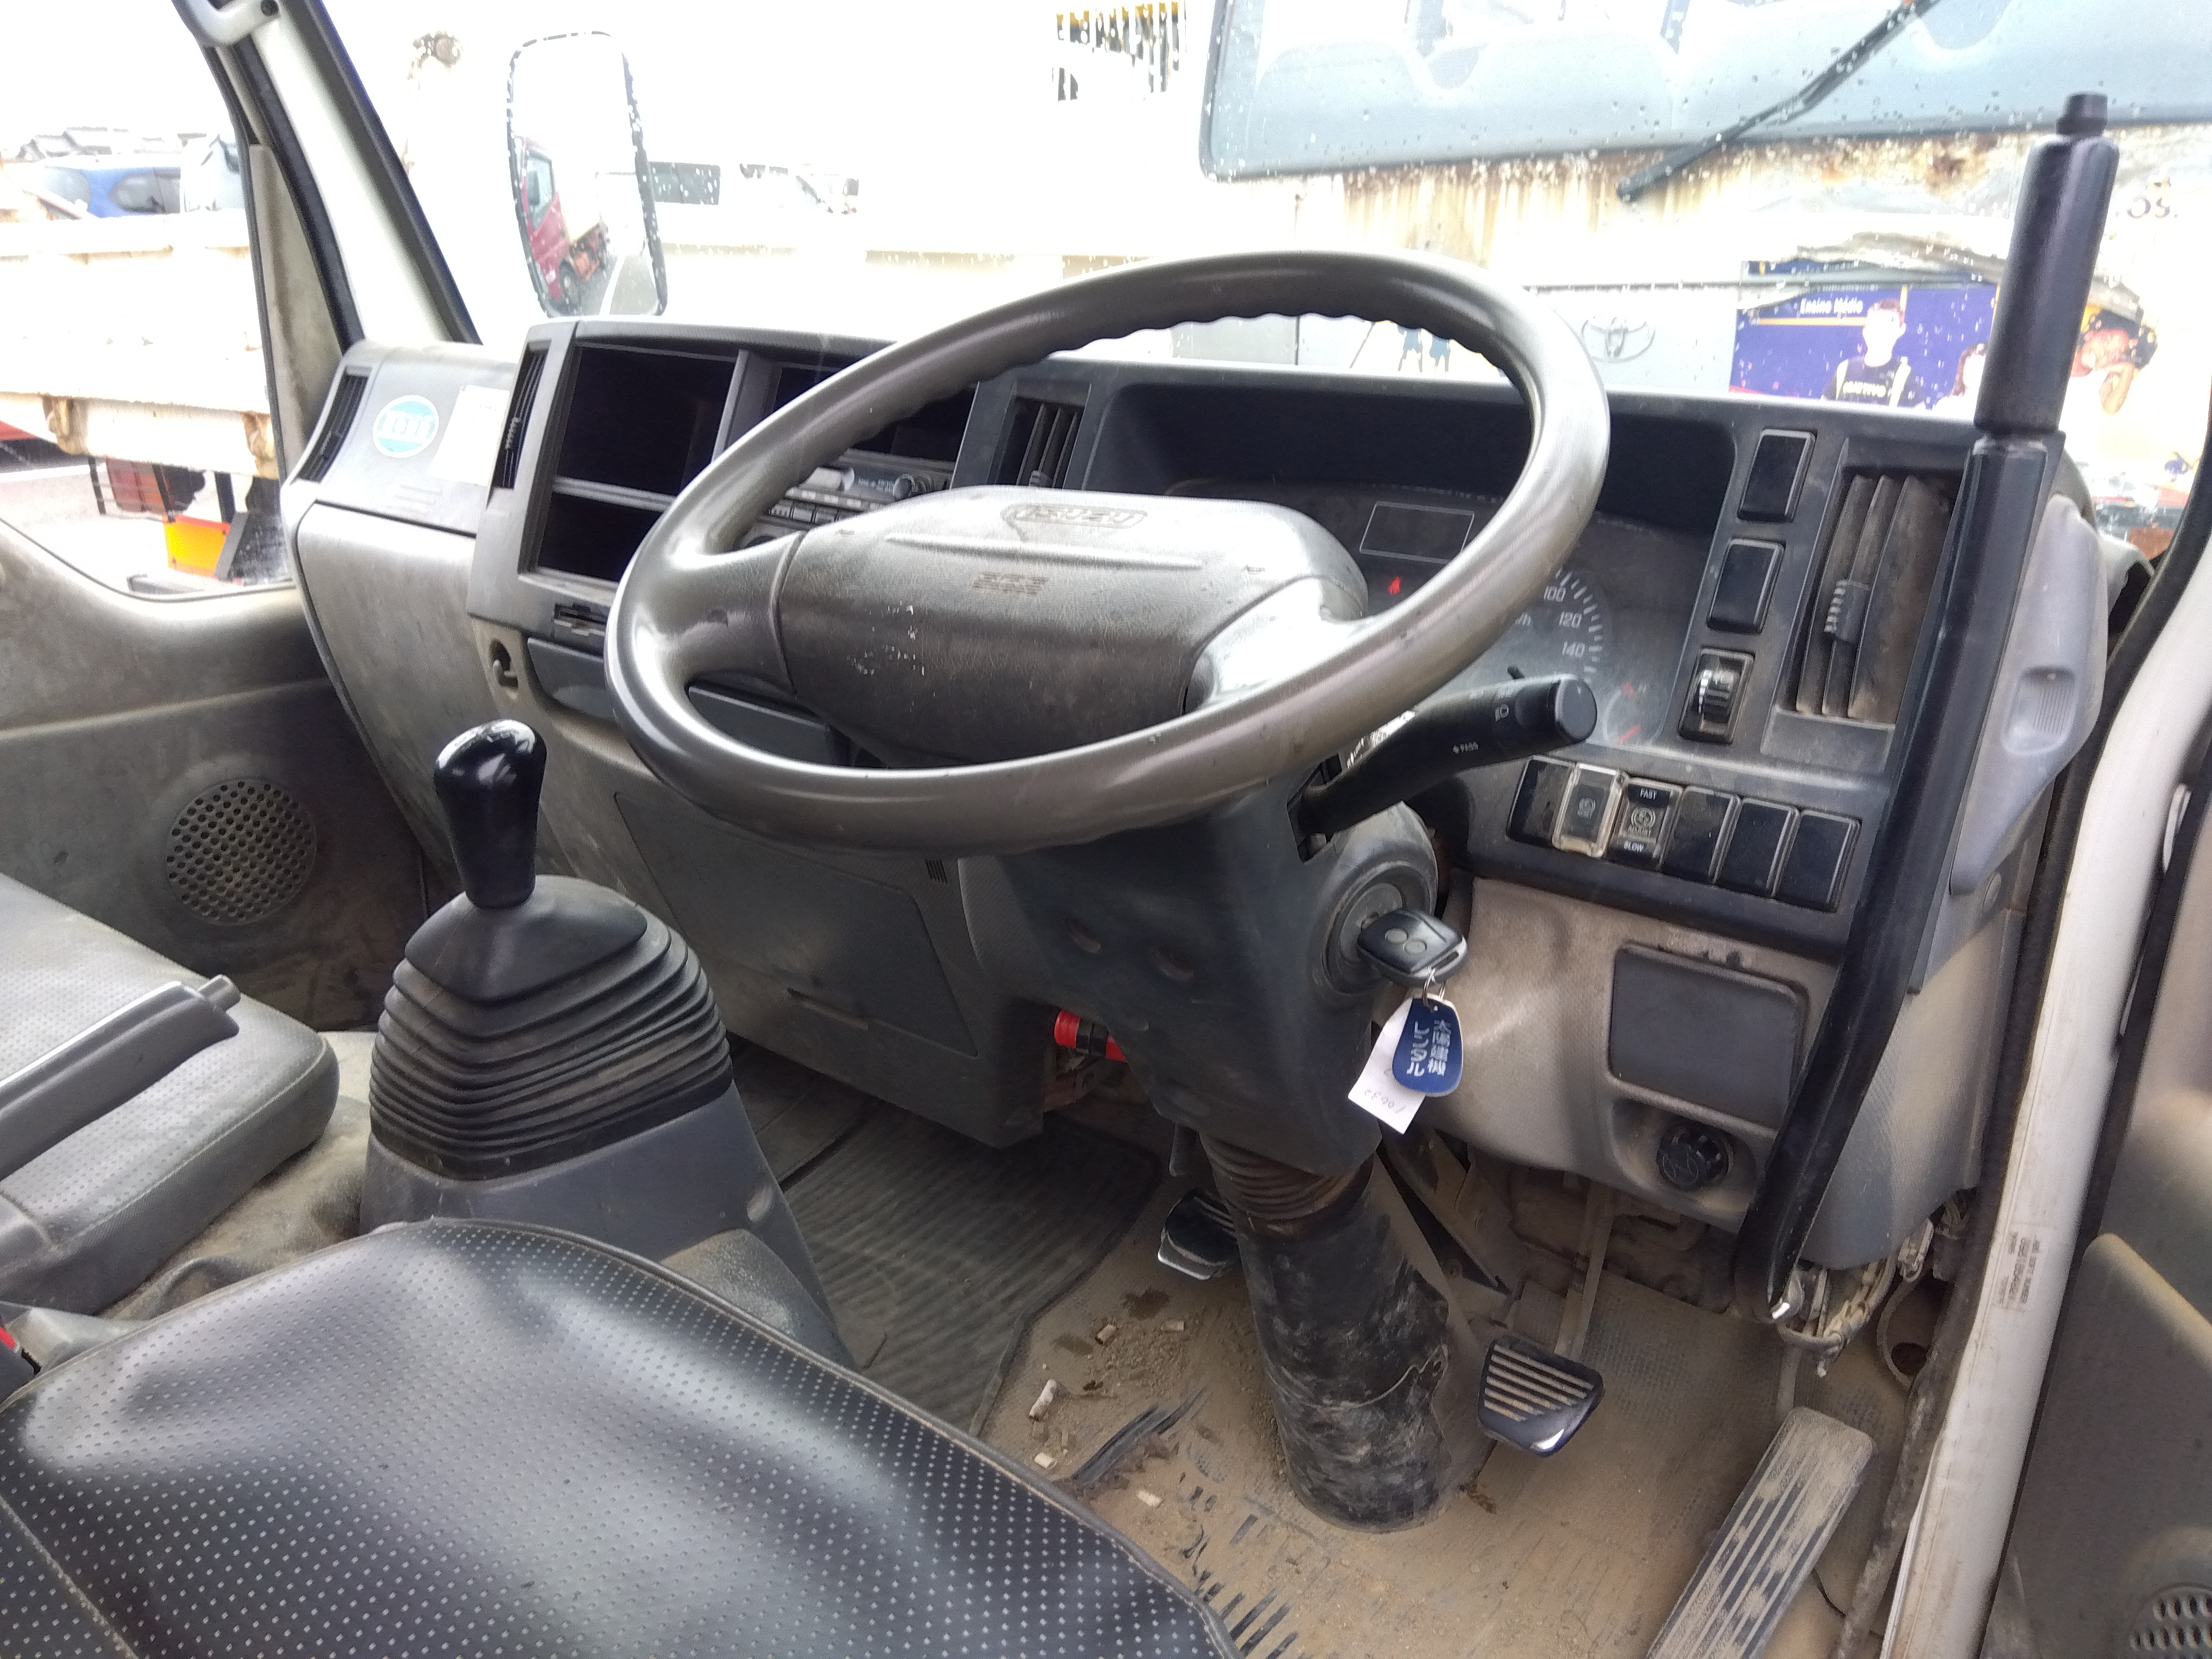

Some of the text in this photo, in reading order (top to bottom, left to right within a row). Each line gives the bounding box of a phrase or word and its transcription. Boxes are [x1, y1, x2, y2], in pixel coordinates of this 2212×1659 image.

[1544, 585, 1566, 602] 100
[1559, 611, 1582, 628] 120
[1562, 641, 1585, 658] 140
[1640, 788, 1657, 800] FAST
[1623, 840, 1644, 852] SLOW
